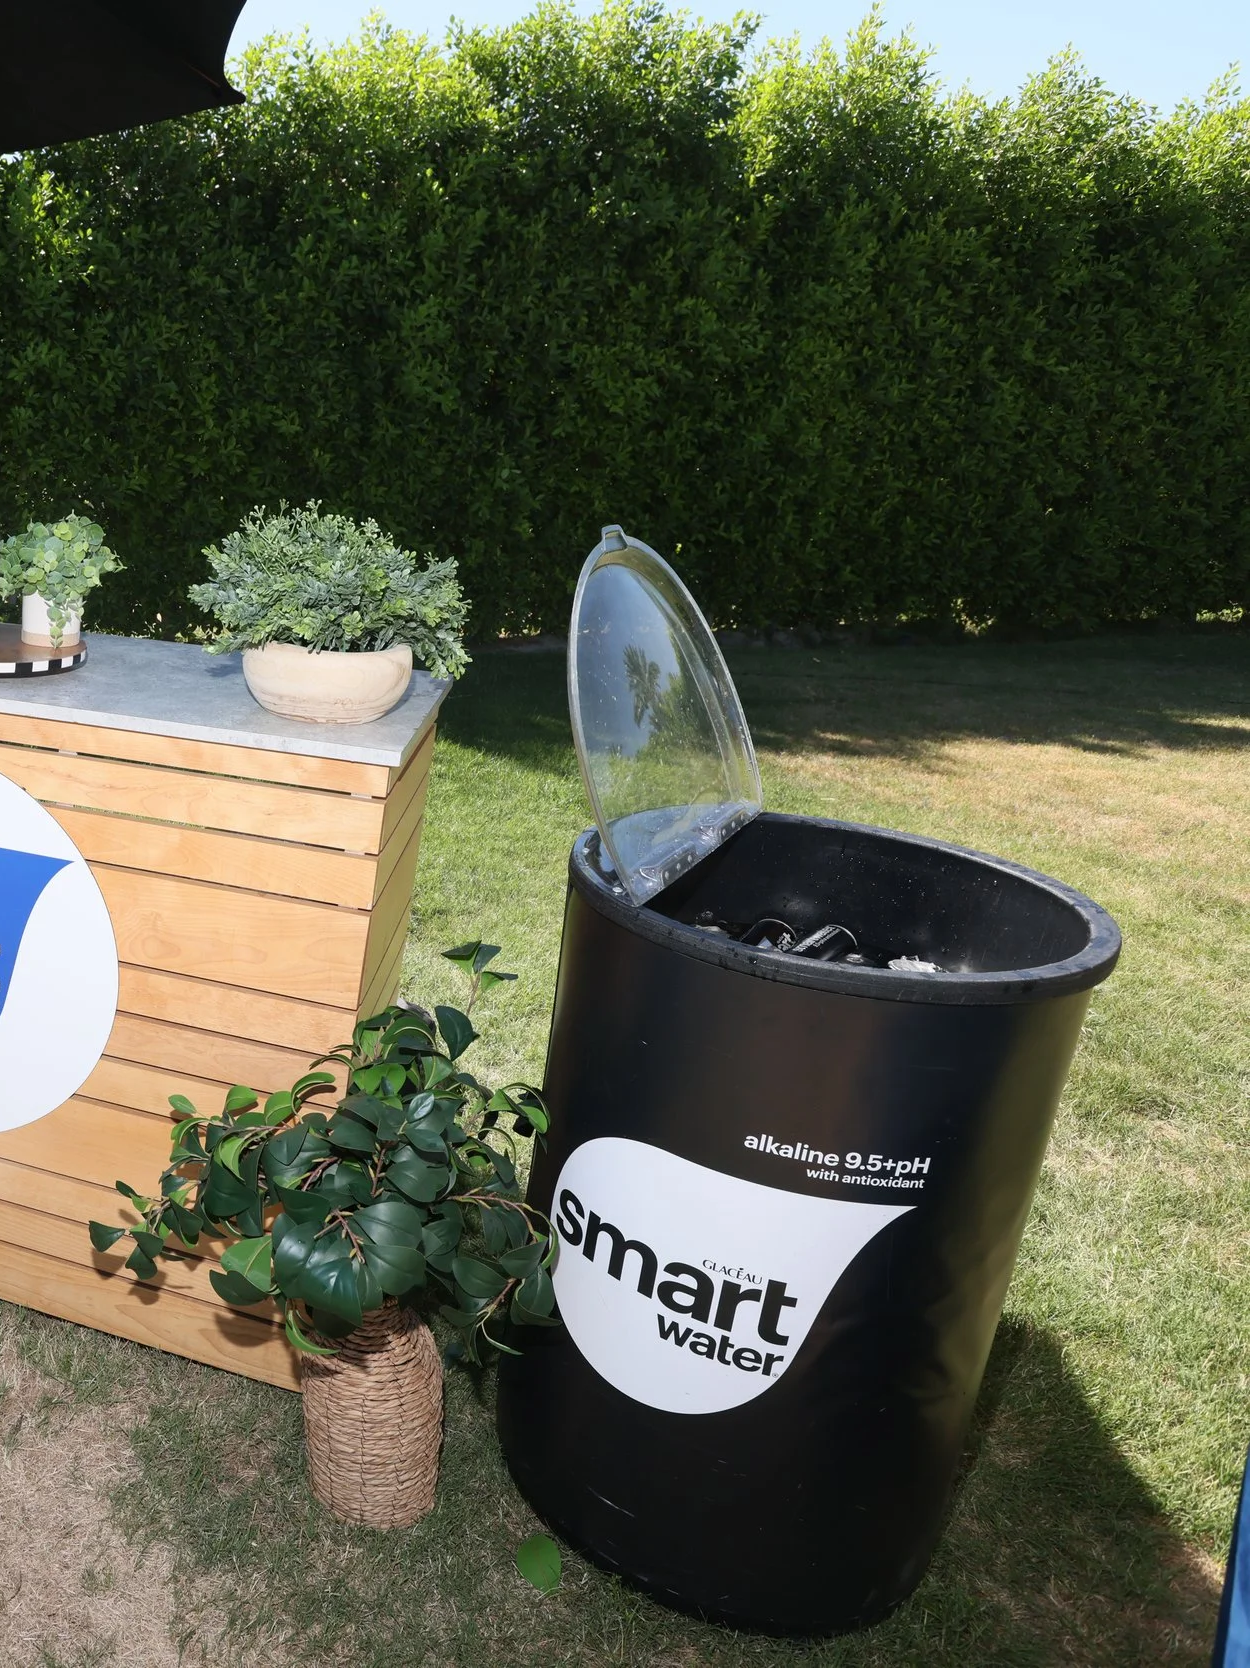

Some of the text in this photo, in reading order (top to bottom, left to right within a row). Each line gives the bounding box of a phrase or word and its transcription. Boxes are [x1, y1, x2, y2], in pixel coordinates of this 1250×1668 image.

[744, 1133, 931, 1177] alkaline 9.5+pH
[806, 1167, 925, 1190] with antioxidant
[556, 1188, 798, 1346] smart
[702, 1259, 763, 1285] GLACÉAU
[657, 1313, 785, 1377] water
